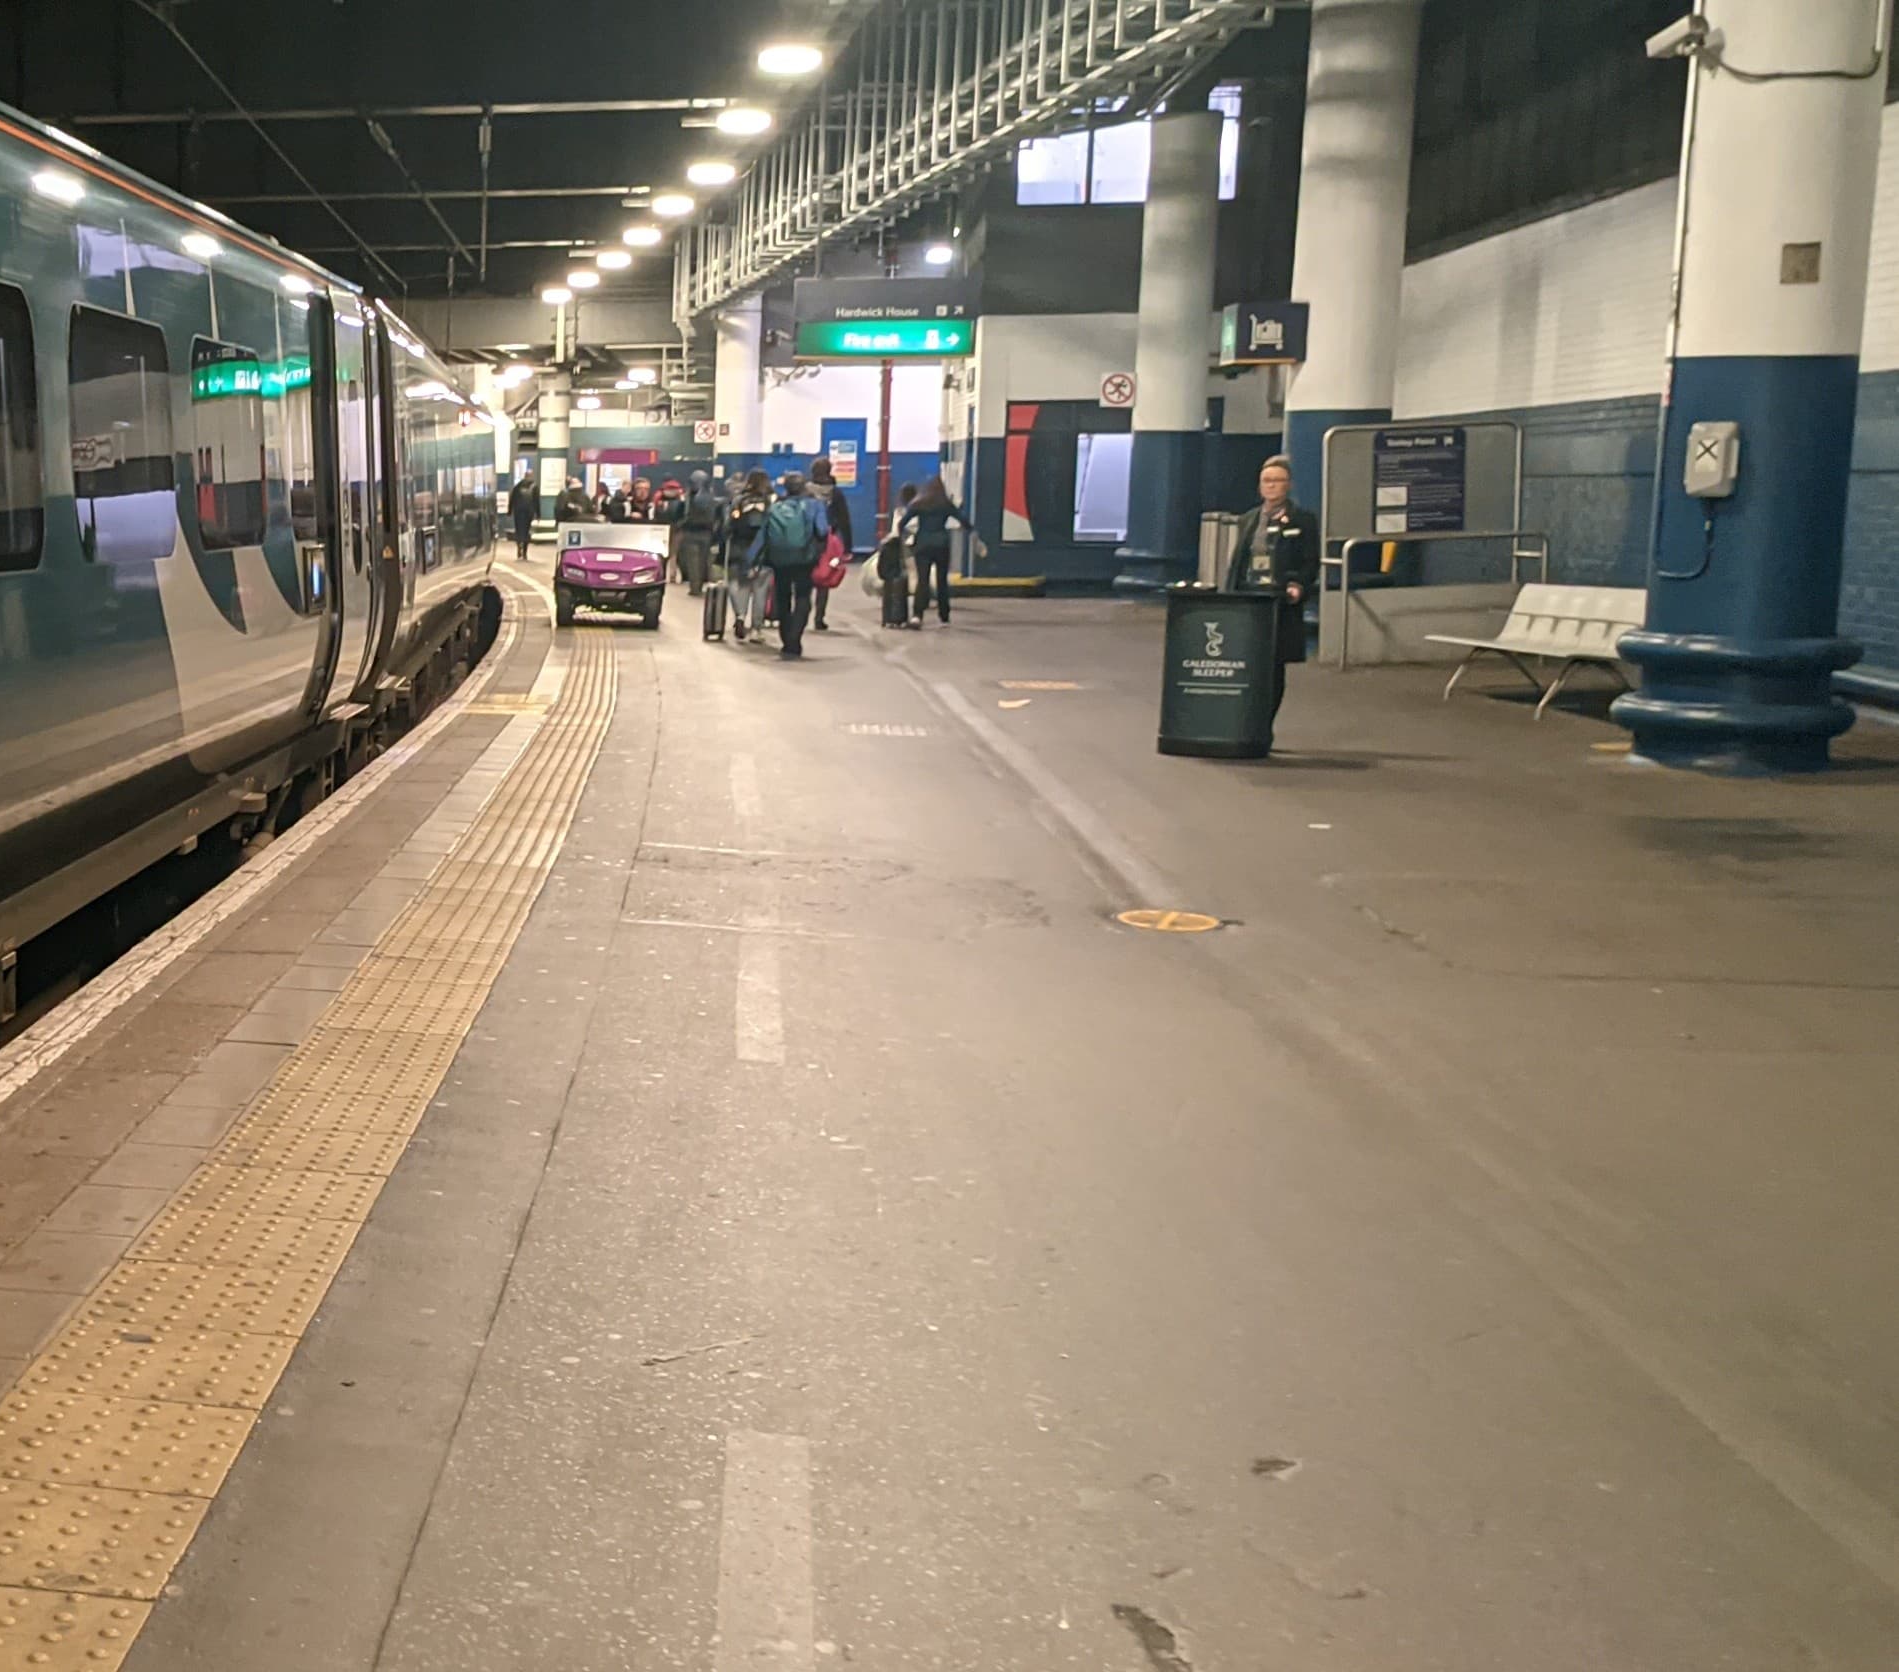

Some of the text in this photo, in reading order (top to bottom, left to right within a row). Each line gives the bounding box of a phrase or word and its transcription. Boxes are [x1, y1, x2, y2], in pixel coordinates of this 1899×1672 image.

[835, 305, 919, 318] Hardwick House
[1182, 660, 1246, 669] CALEDONIAN
[1192, 669, 1234, 677] SLEEPER
